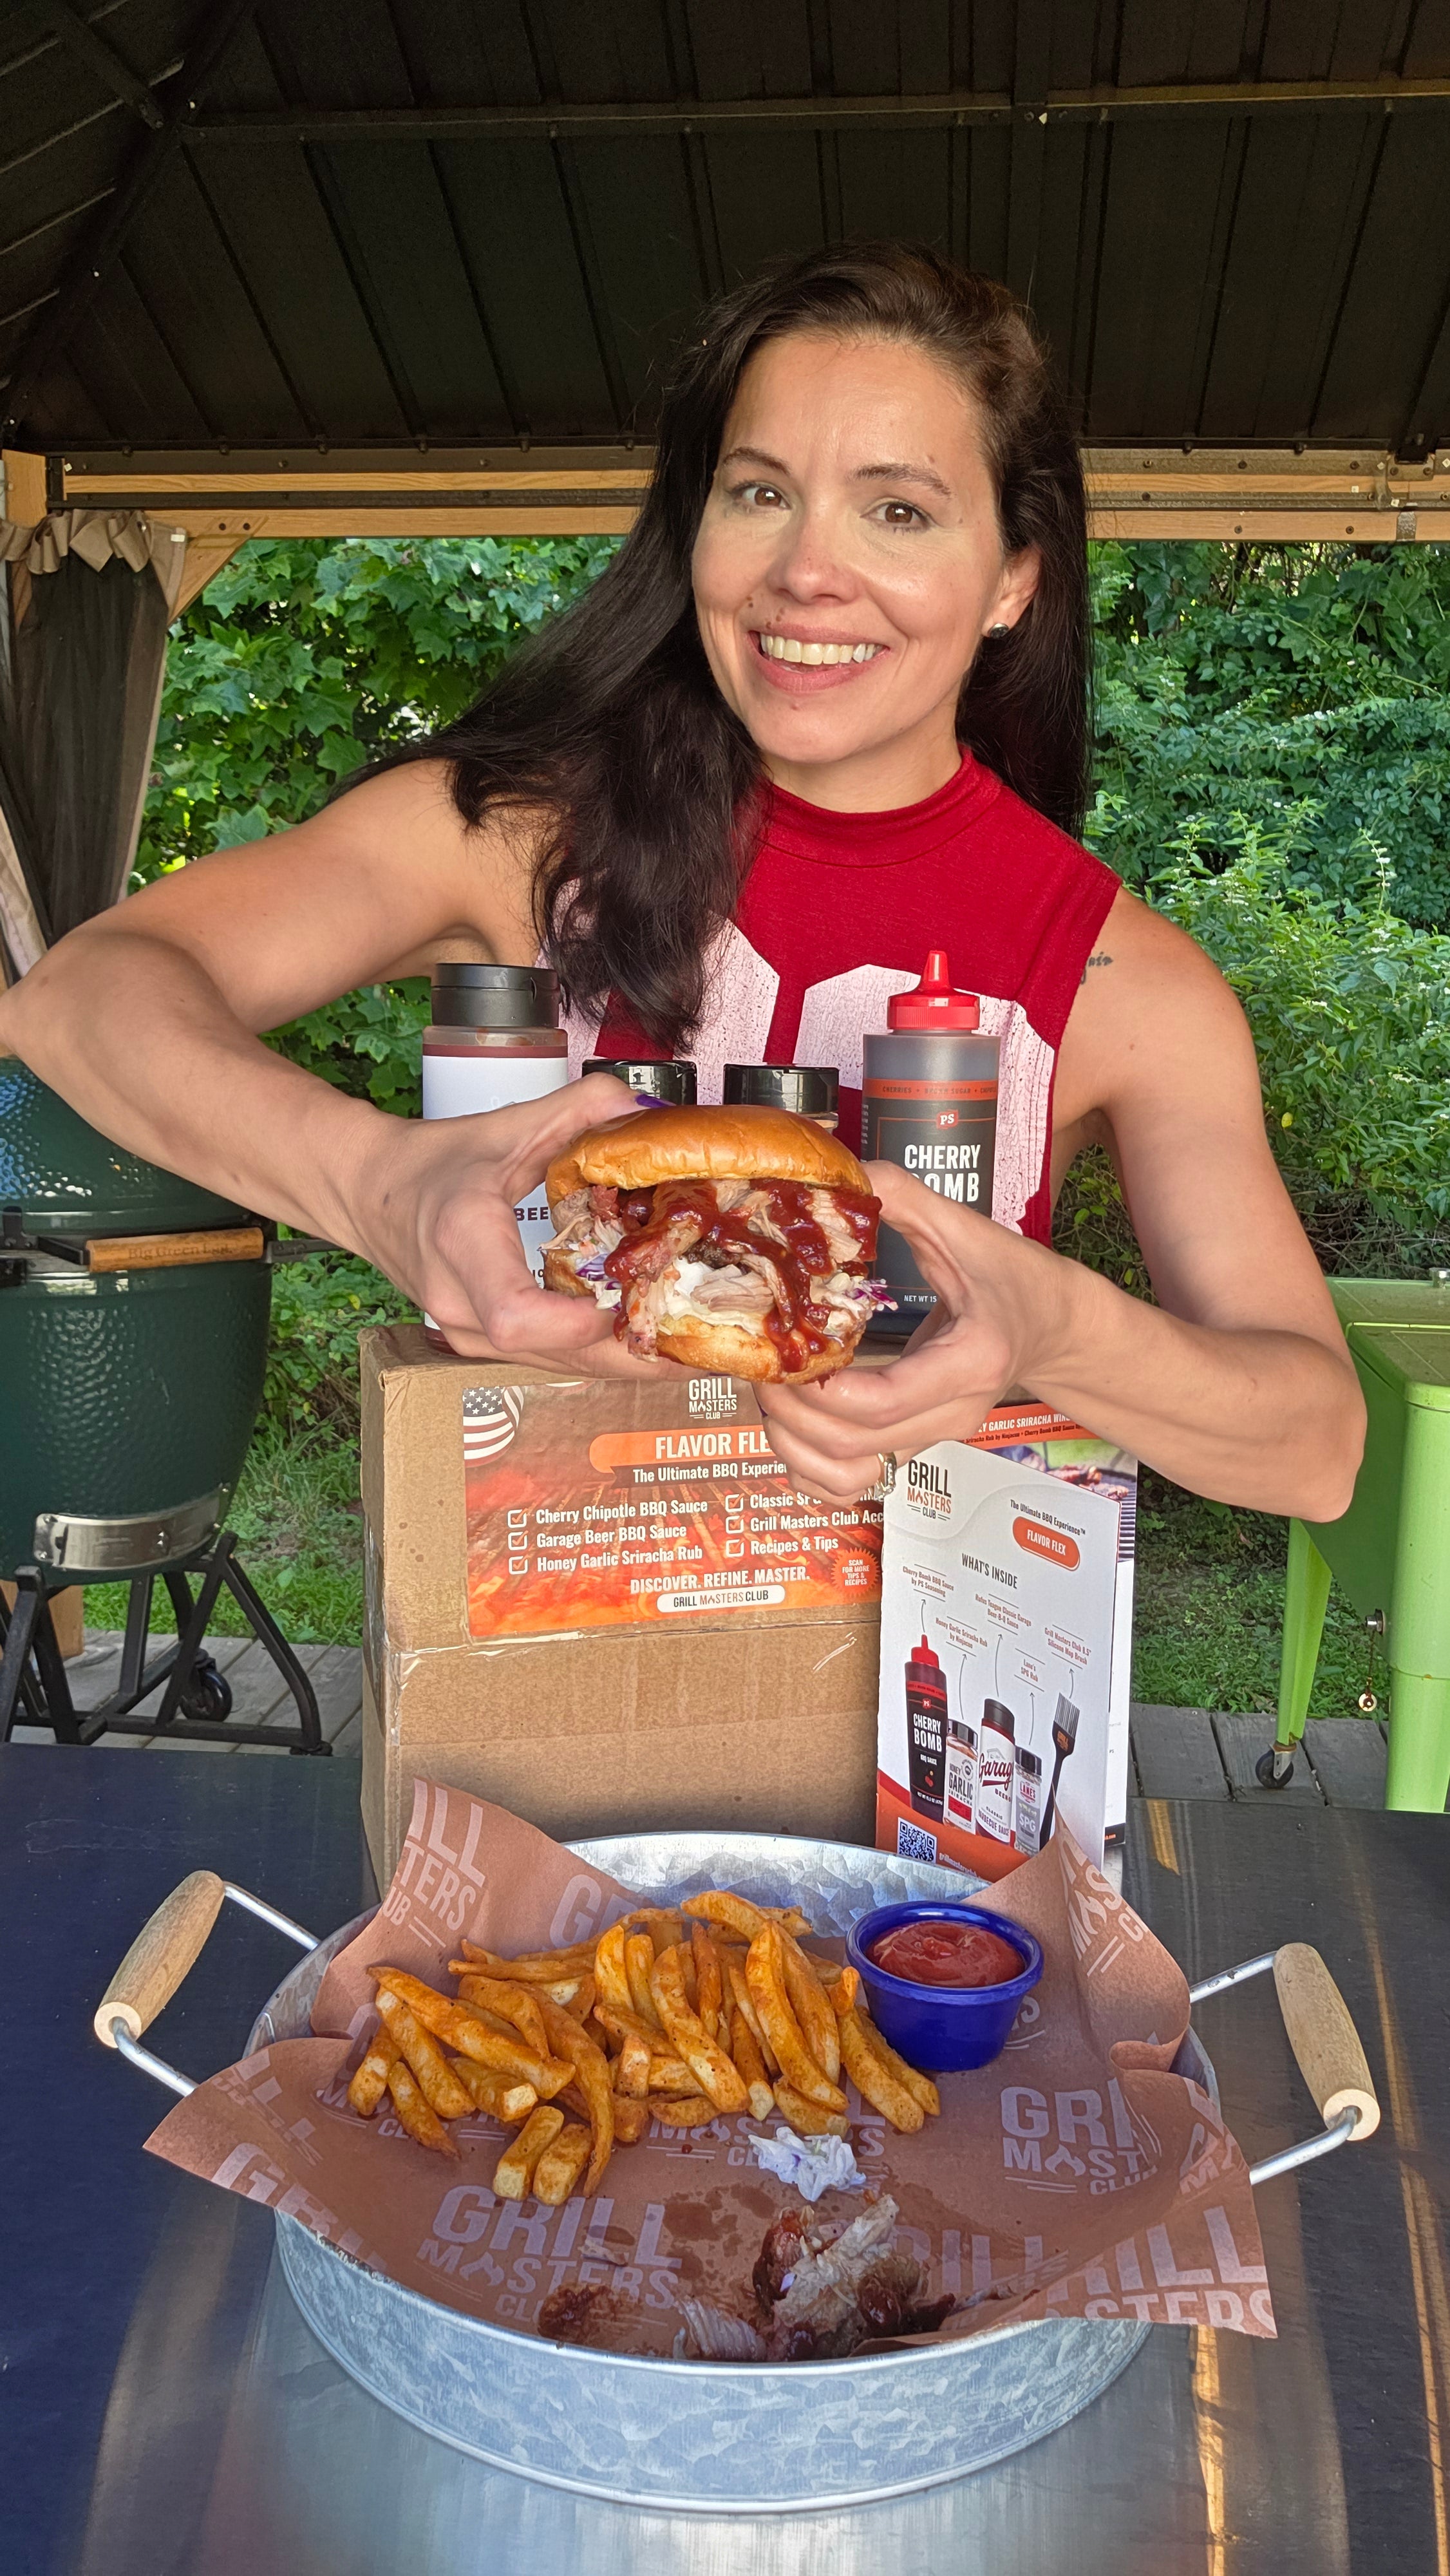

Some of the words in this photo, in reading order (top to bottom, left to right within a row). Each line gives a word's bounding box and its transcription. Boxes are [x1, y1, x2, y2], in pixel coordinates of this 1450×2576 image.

[940, 1113, 955, 1126] PS
[904, 1144, 981, 1170] CHERRY
[513, 1206, 549, 1222] BEE
[155, 1245, 200, 1257] Green
[688, 1377, 737, 1401] GRILL
[689, 1399, 737, 1413] MASTERS
[988, 1419, 1015, 1432] GARLIC
[1016, 1414, 1051, 1428] SRIRACHA
[1053, 1413, 1071, 1423] WIN
[655, 1433, 732, 1459] FLAVOR
[738, 1430, 773, 1455] FLE
[632, 1468, 655, 1483] The
[657, 1466, 709, 1482] Ultimate
[712, 1463, 738, 1479] BBQ
[741, 1460, 787, 1478] Experie
[907, 1459, 952, 1498] GRILL
[536, 1508, 579, 1524] Cherry
[583, 1502, 636, 1522] Chipotle
[639, 1502, 668, 1517] BBQ
[670, 1500, 708, 1515] Sauce
[749, 1492, 793, 1508] Classic
[907, 1486, 952, 1514] MASTERS
[1010, 1499, 1019, 1511] The
[1020, 1502, 1041, 1519] Ultimate
[1042, 1511, 1053, 1525] BBQ
[750, 1515, 777, 1532] Grill
[780, 1514, 829, 1530] Masters
[831, 1511, 859, 1526] Club
[862, 1510, 883, 1524] Acc
[922, 1506, 937, 1520] CLUB
[536, 1532, 581, 1549] Garage
[585, 1529, 615, 1544] Beer
[619, 1526, 645, 1543] BBQ
[649, 1524, 687, 1540] Sauce
[750, 1539, 798, 1556] Recipes
[802, 1537, 811, 1551] &
[813, 1536, 839, 1552] Tips
[1026, 1529, 1051, 1551] FLAVOR
[1051, 1539, 1067, 1556] FLEX
[537, 1556, 577, 1573] Honey
[580, 1551, 619, 1569] Garlic
[621, 1547, 674, 1565] Sriracha
[677, 1545, 703, 1561] Rub
[961, 1553, 990, 1577] WHAT'S
[992, 1566, 1018, 1589] INSIDE
[630, 1575, 701, 1594] DISCOVER.
[703, 1569, 753, 1588] REFINE.
[754, 1566, 810, 1586] MASTER.
[844, 1578, 867, 1586] RECIPES
[902, 1566, 918, 1577] Cherry
[932, 1575, 942, 1586] BBQ
[942, 1580, 954, 1591] Sauce
[911, 1577, 917, 1586] by
[673, 1595, 697, 1608] GRILL
[699, 1592, 744, 1605] MASTERS
[745, 1590, 769, 1602] CLUB
[913, 1712, 941, 1734] CHERRY
[914, 1727, 942, 1752] BOMB
[978, 1752, 1013, 1792] Garag
[948, 1772, 974, 1801] GARLIC
[408, 1777, 486, 1888] ILL
[1019, 1813, 1036, 1833] SPG
[404, 1839, 476, 1931] TERS
[381, 1886, 411, 1926] UB
[1000, 2077, 1135, 2149] GRI
[1002, 2137, 1142, 2177] MAST
[432, 2184, 683, 2269] GRILL
